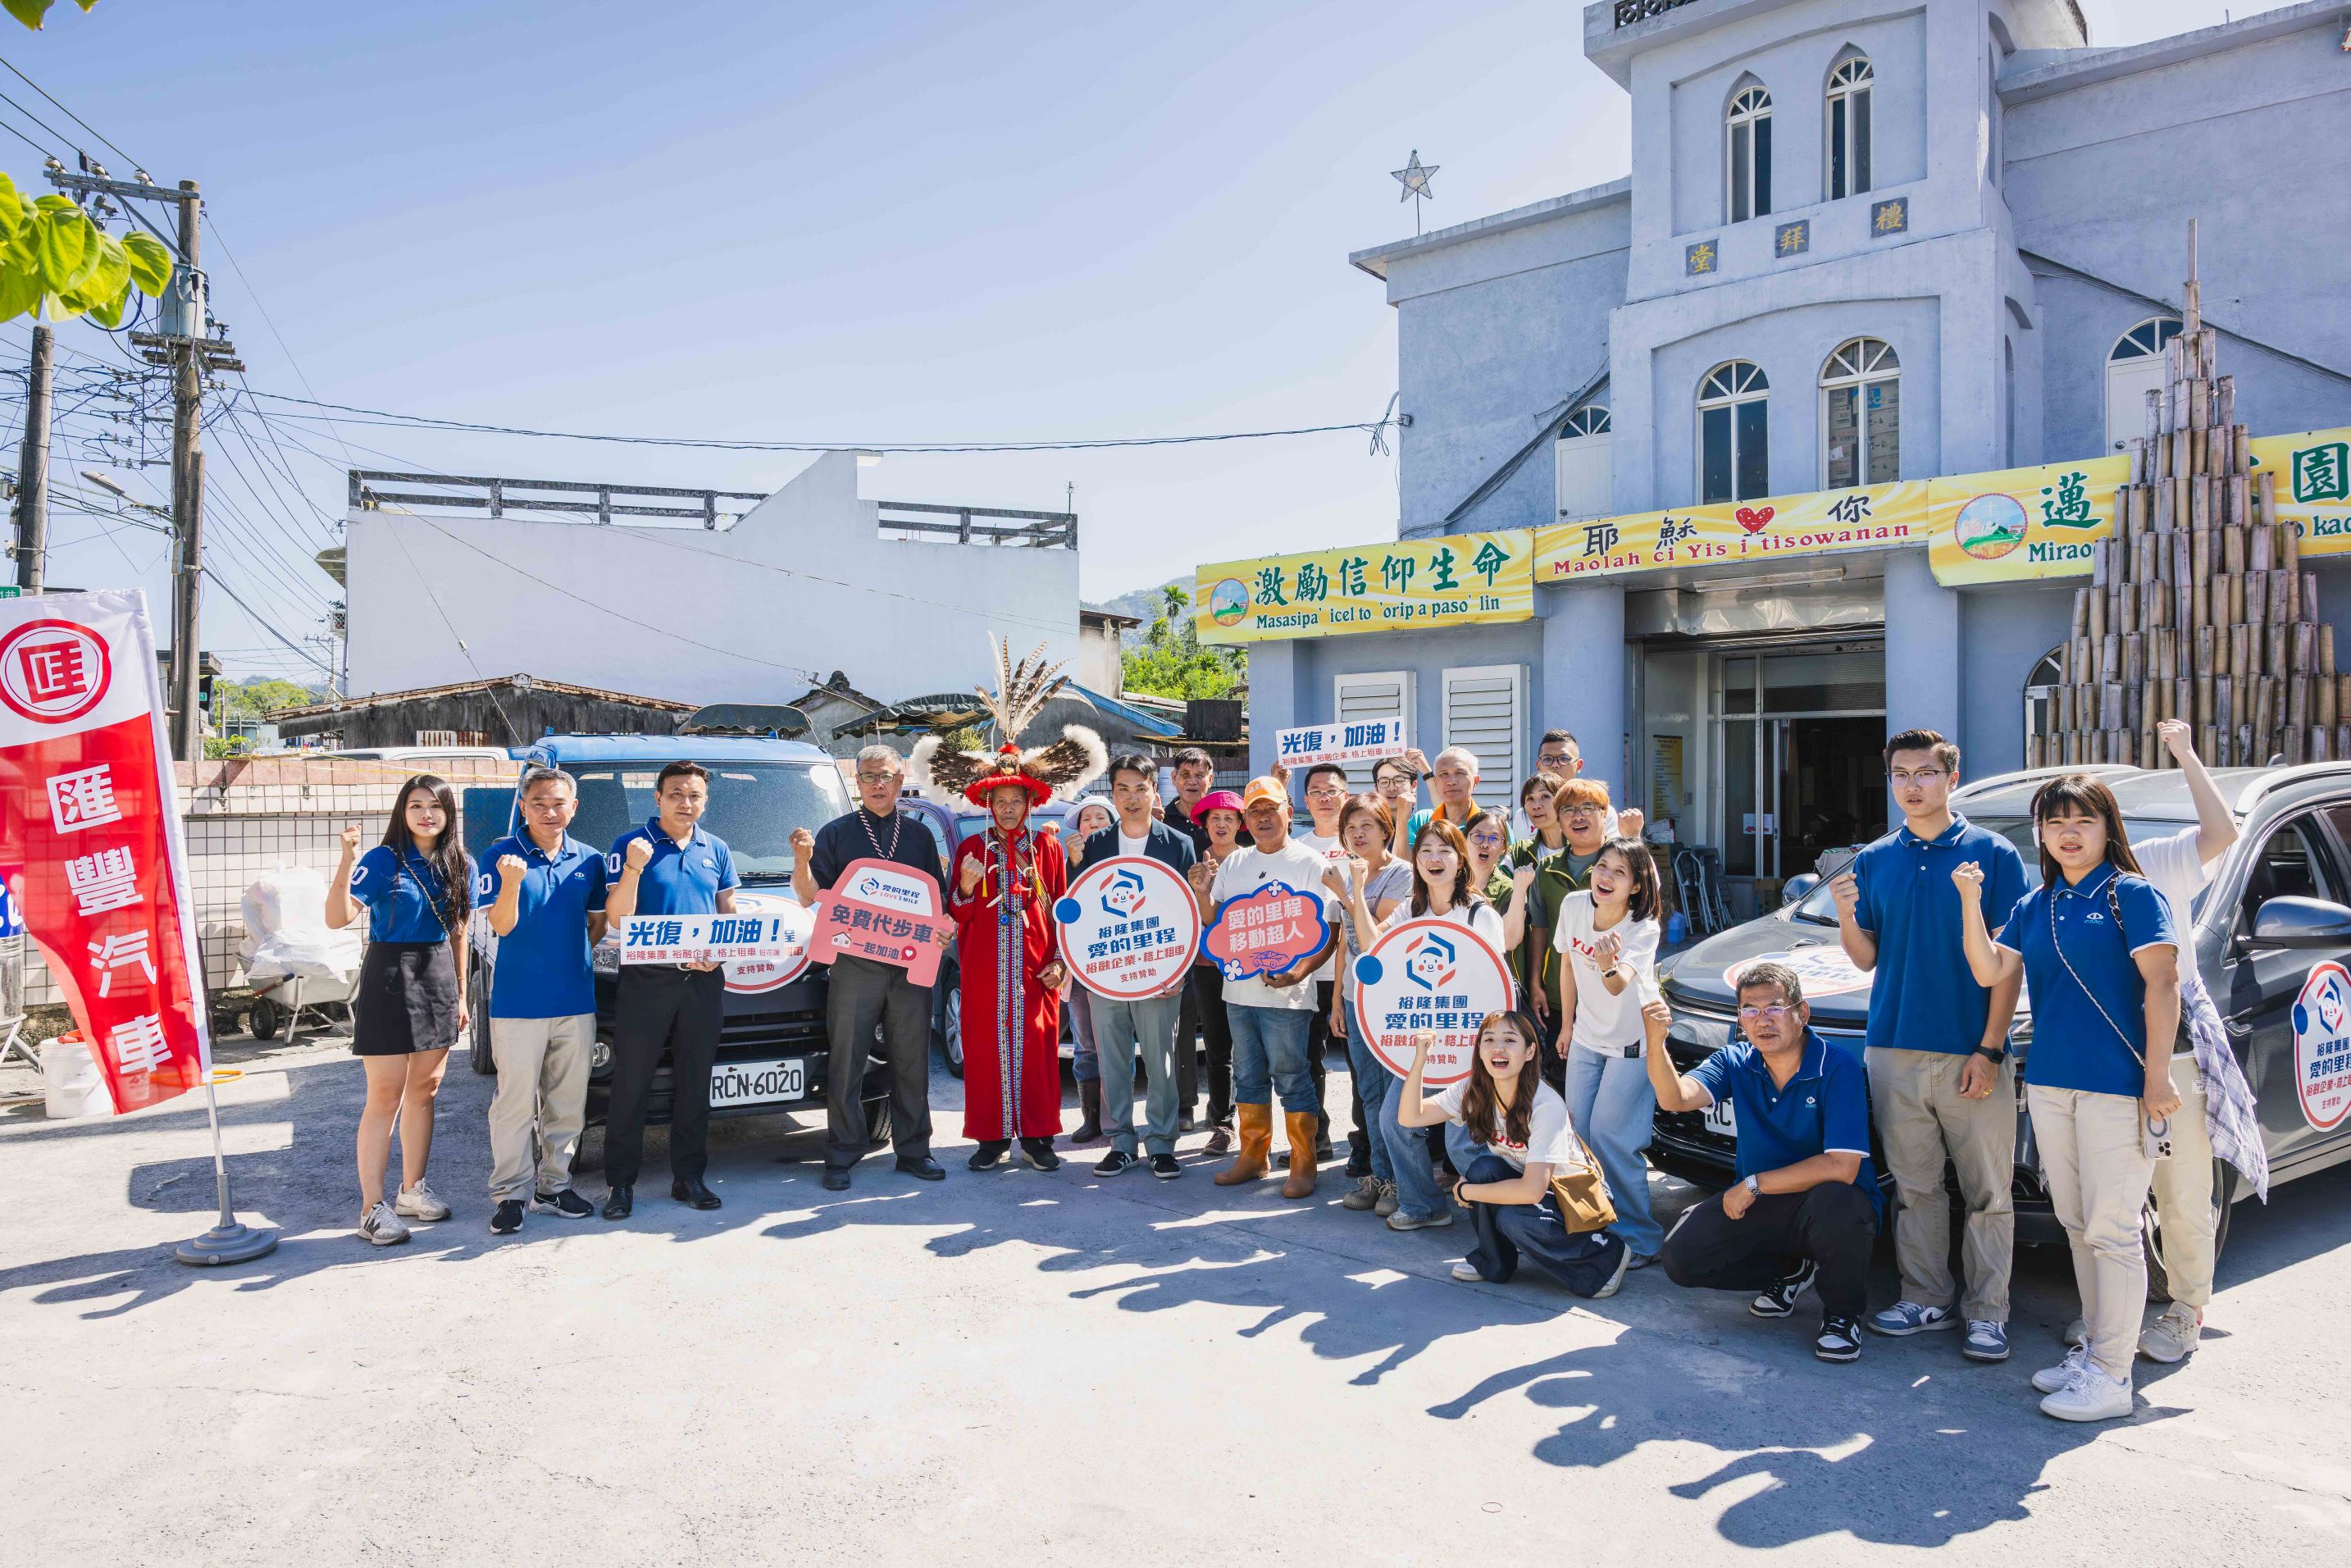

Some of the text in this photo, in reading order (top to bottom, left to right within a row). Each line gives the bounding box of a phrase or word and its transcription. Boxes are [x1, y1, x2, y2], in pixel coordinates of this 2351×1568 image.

[2040, 442, 2349, 529] 邁 園
[1828, 495, 1872, 523] 你
[1553, 524, 1910, 574] Maolah ci Yis i tisowanan
[2029, 541, 2095, 563] Mirao
[1254, 541, 1510, 607] 激勵信仰生命
[1329, 607, 1355, 623] icel
[1358, 605, 1372, 621] to
[1418, 604, 1427, 616] a
[1479, 595, 1500, 612] lin
[882, 884, 920, 899] 愛的里程
[46, 763, 173, 1074] 匯豐汽車
[830, 904, 933, 943] 免費代步車
[1098, 916, 1160, 939] 裕隆集團
[1228, 896, 1303, 931] 愛的里程
[853, 942, 900, 960] 一起加油
[1087, 928, 1176, 959] 愛的里程
[1229, 921, 1305, 953] 移動超人
[1398, 995, 1468, 1010] 裕隆集團
[1385, 1012, 1484, 1030] 愛的里程
[1427, 1054, 1457, 1064] 持贊助
[2317, 1037, 2350, 1056] 裕隆集團
